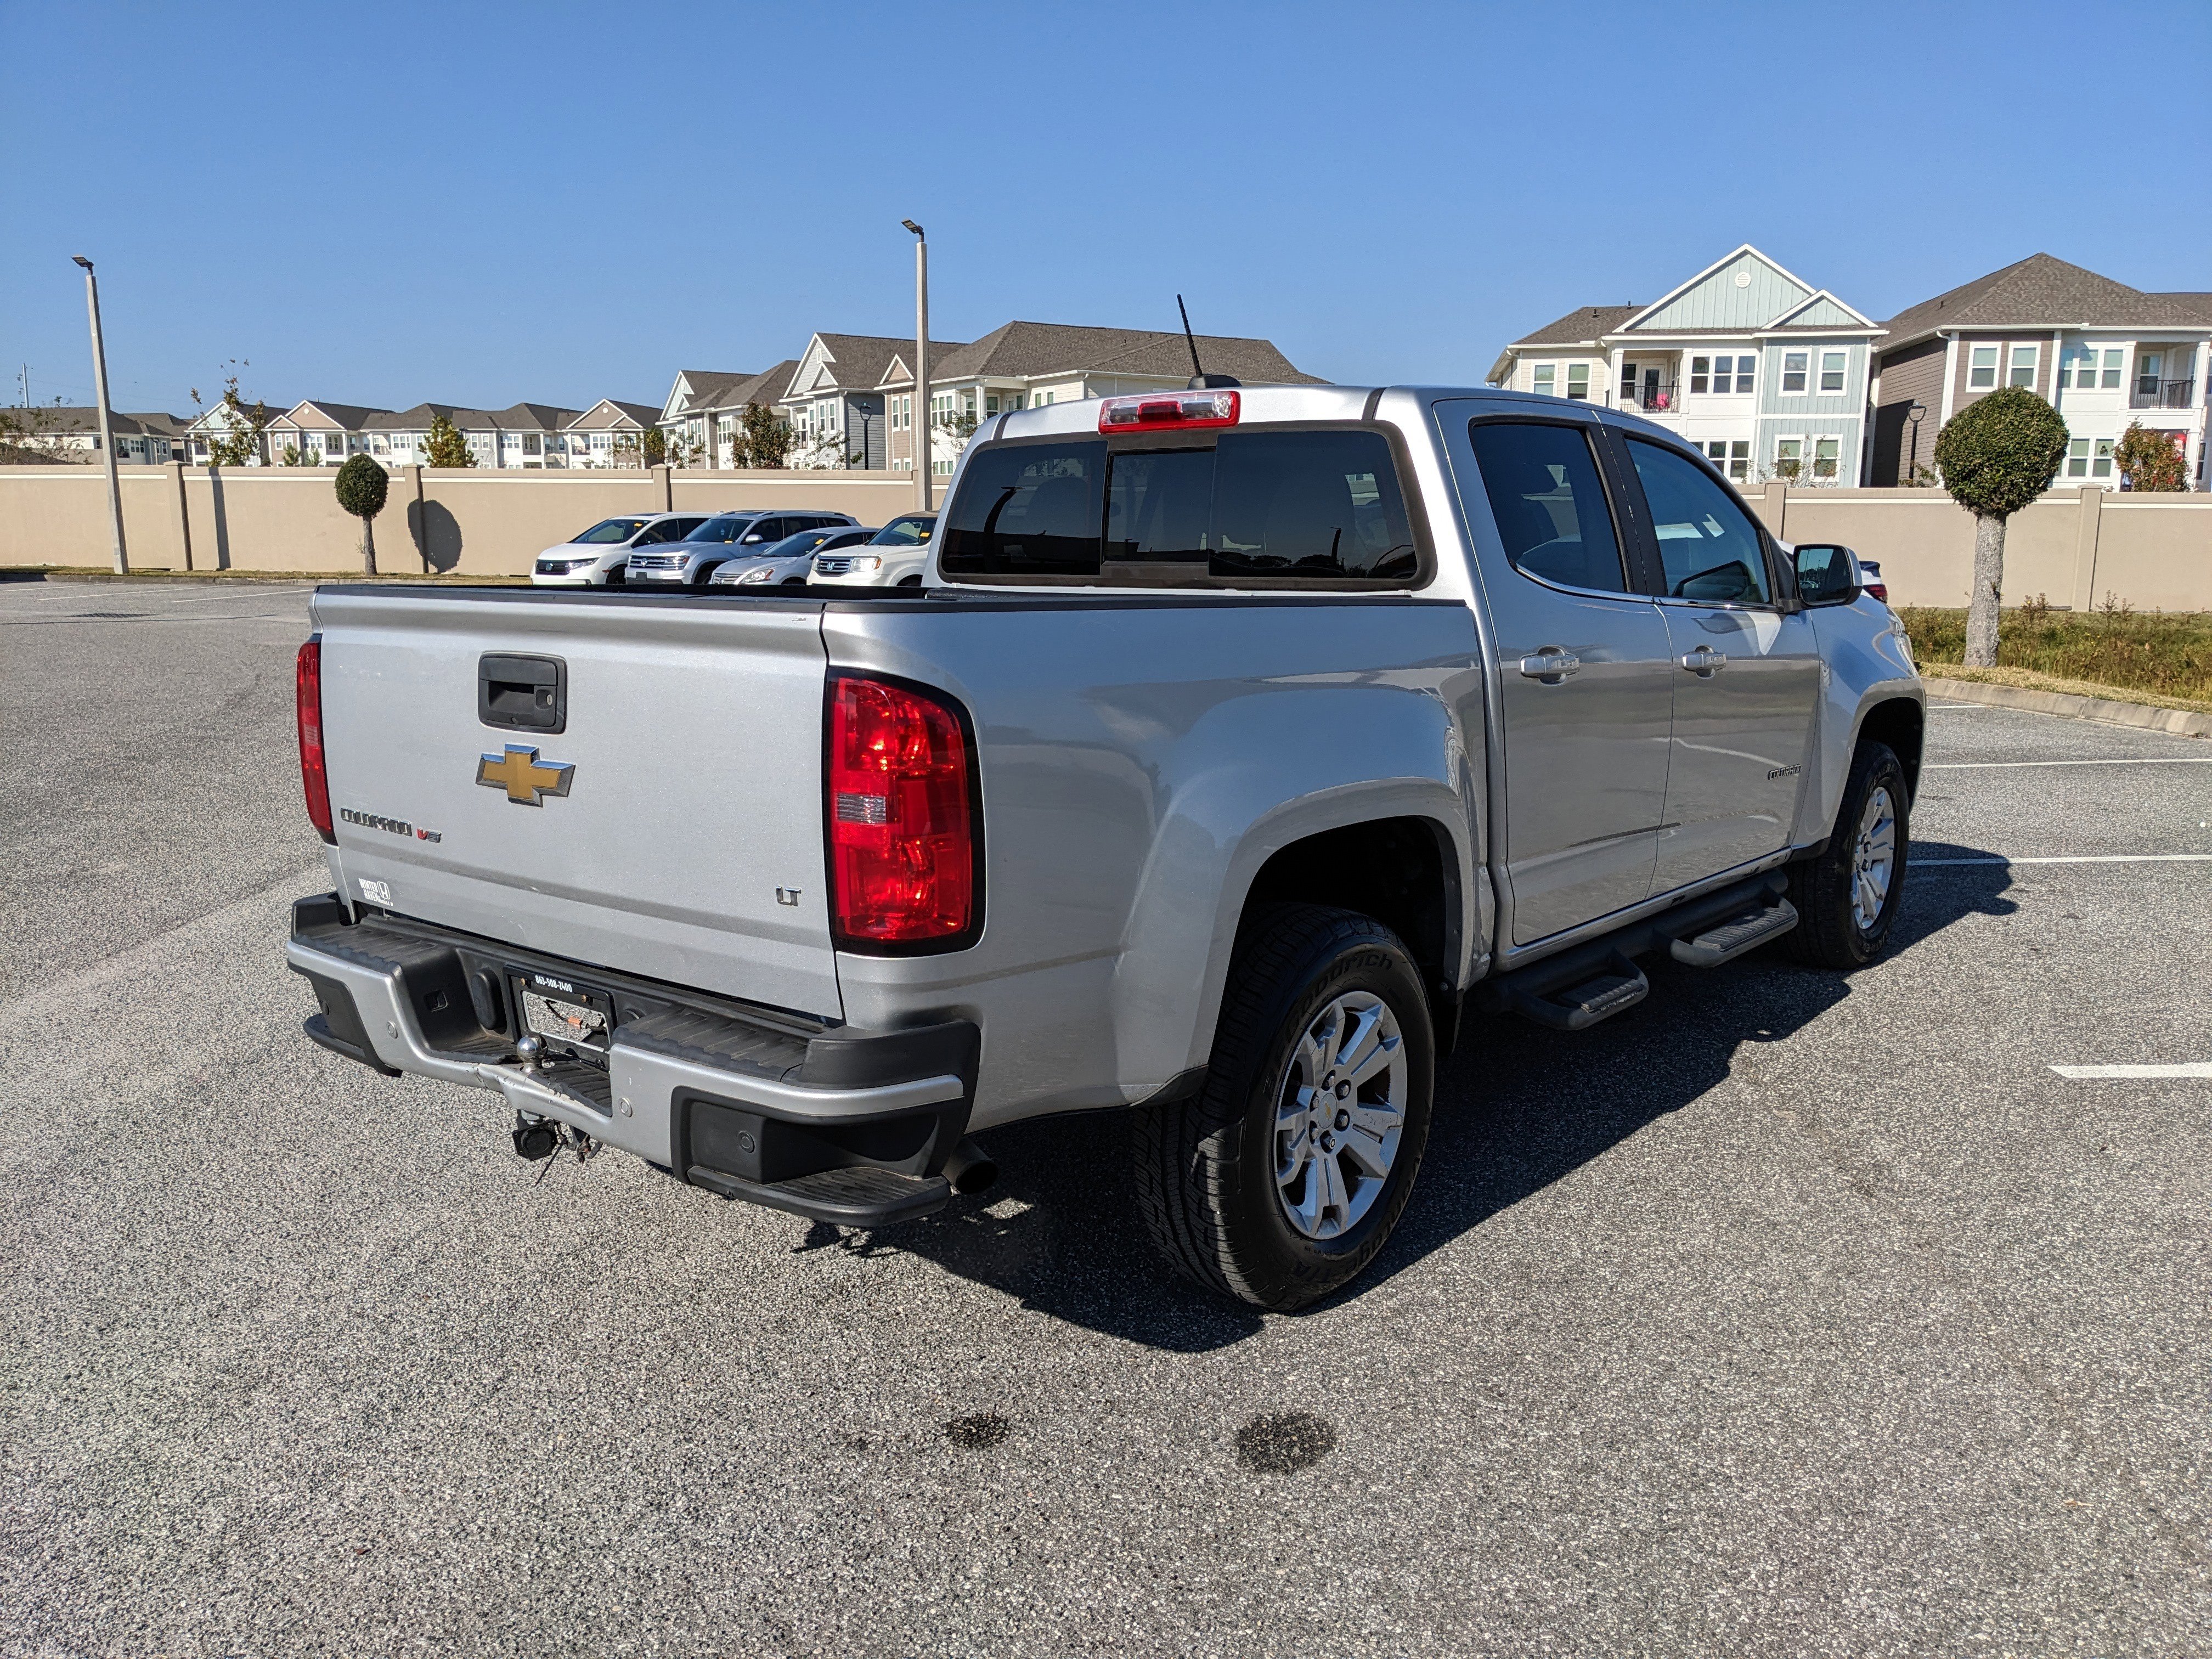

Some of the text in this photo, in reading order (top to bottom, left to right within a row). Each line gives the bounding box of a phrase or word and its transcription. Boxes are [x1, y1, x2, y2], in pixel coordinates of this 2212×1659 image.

[1768, 764, 1802, 780] COLORADO
[340, 808, 442, 843] COLORADO V6
[775, 885, 802, 907] LT
